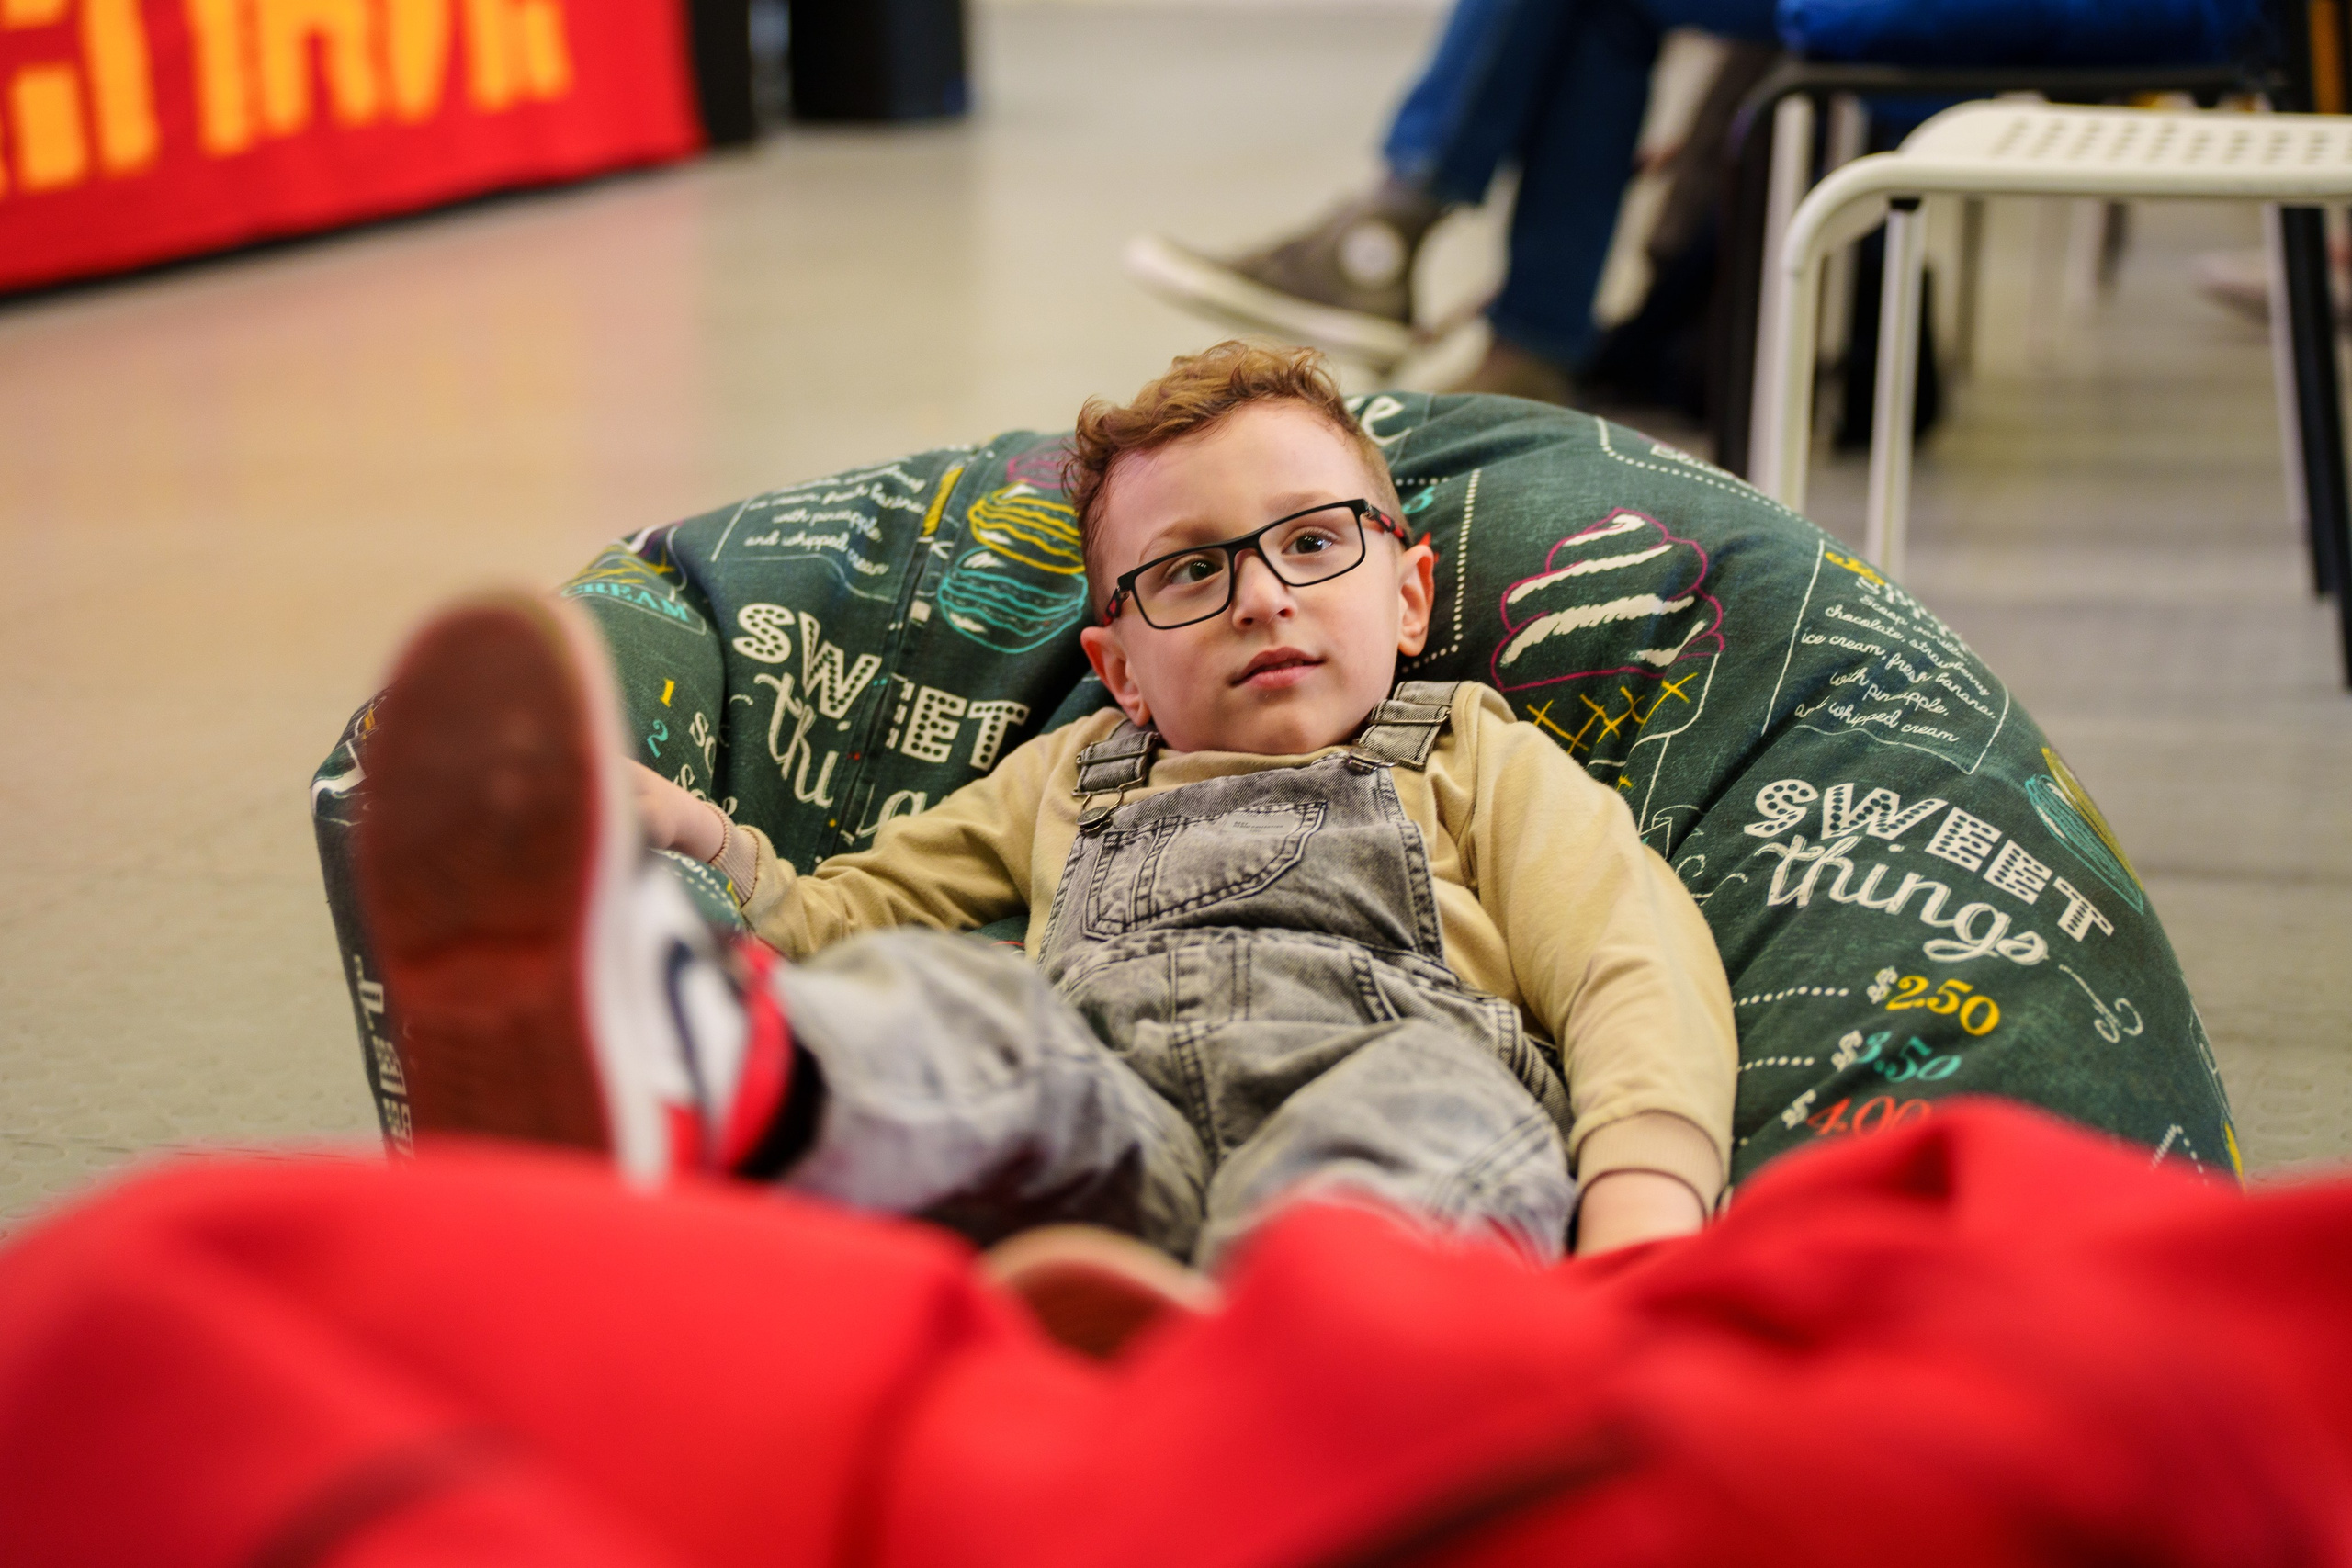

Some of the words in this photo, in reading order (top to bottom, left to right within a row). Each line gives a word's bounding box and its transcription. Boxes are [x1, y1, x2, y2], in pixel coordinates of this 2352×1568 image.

[1825, 604, 1907, 643] chocolate,
[1802, 632, 1826, 645] ice
[1828, 635, 1887, 660] cream,
[1884, 652, 1933, 683] fresh
[1934, 672, 1997, 719] banana,
[1829, 667, 1870, 688] with
[1827, 700, 1902, 728] whipped
[1901, 722, 1960, 743] cream
[1744, 778, 2115, 942] SWEET
[1753, 834, 2050, 966] things
[1866, 965, 2000, 1036] $2.50
[1830, 1029, 1962, 1083] $3.50
